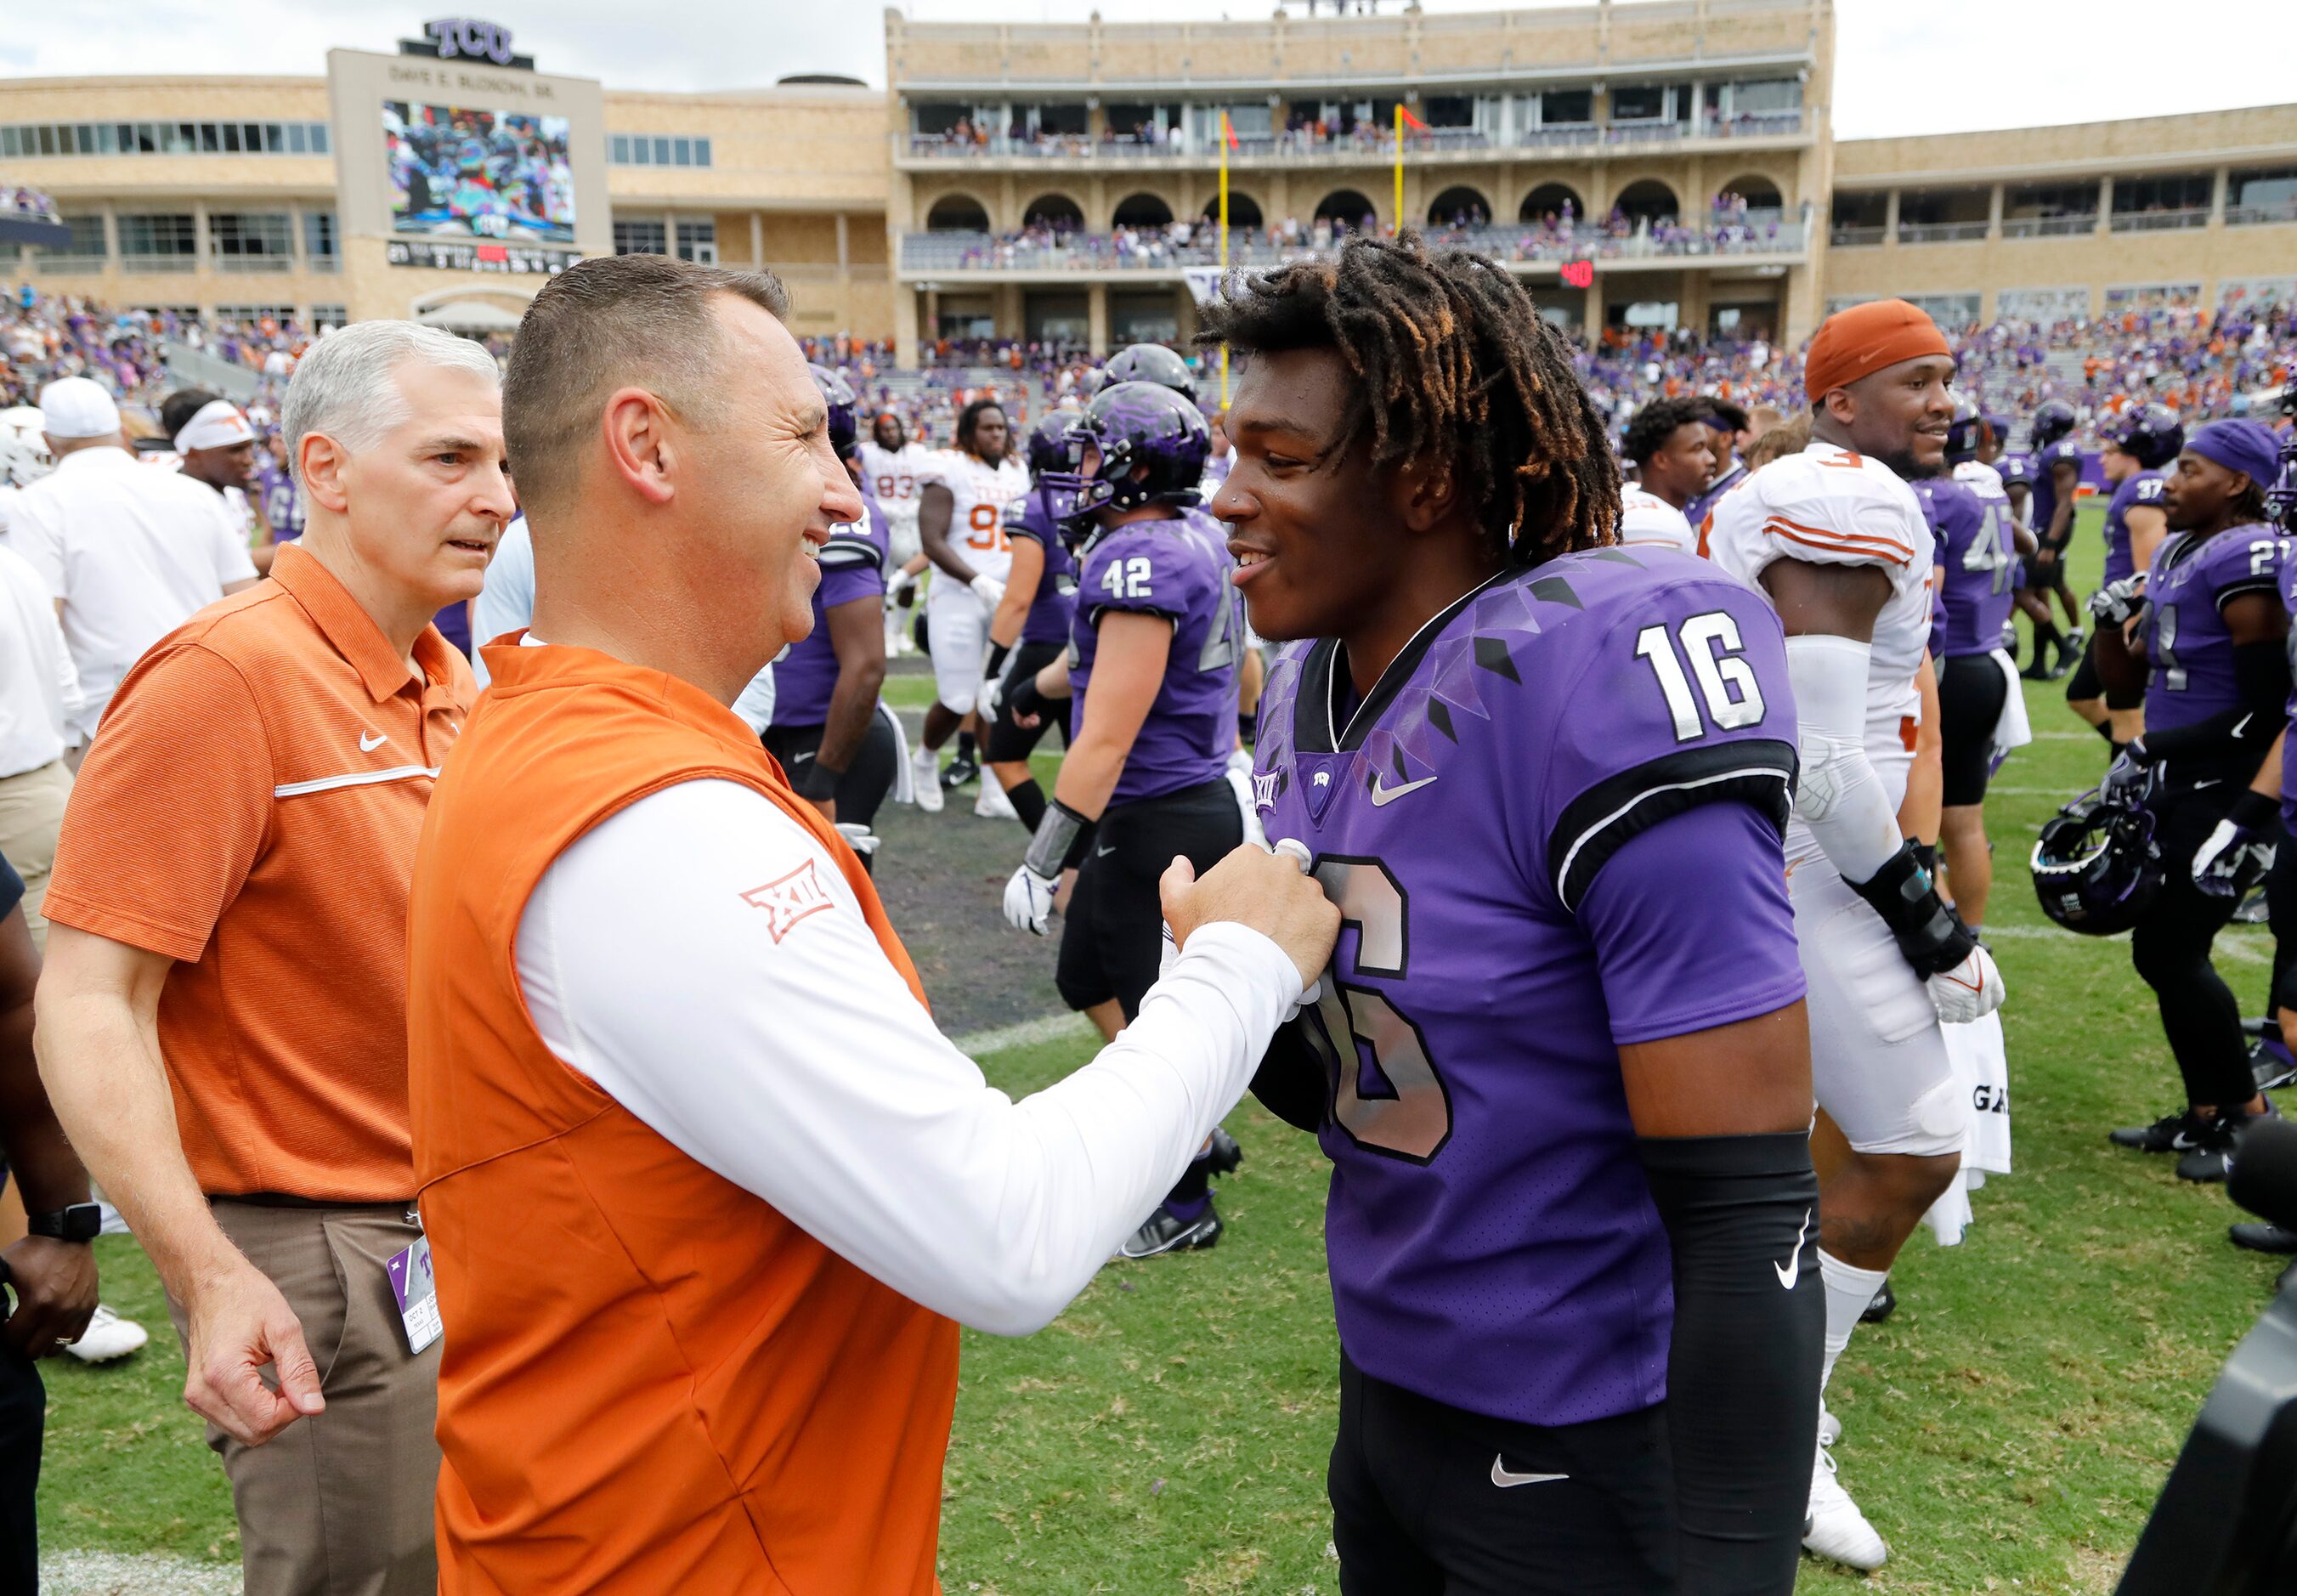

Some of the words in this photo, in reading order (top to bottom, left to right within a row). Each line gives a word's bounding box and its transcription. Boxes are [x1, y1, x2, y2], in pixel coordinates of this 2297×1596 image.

[429, 18, 513, 66] TCU
[1560, 260, 1593, 288] 40
[878, 475, 914, 500] 83
[2136, 478, 2164, 500] 37
[1100, 557, 1152, 599] 42
[1633, 609, 1768, 745] 16
[409, 1310, 419, 1322] OCT
